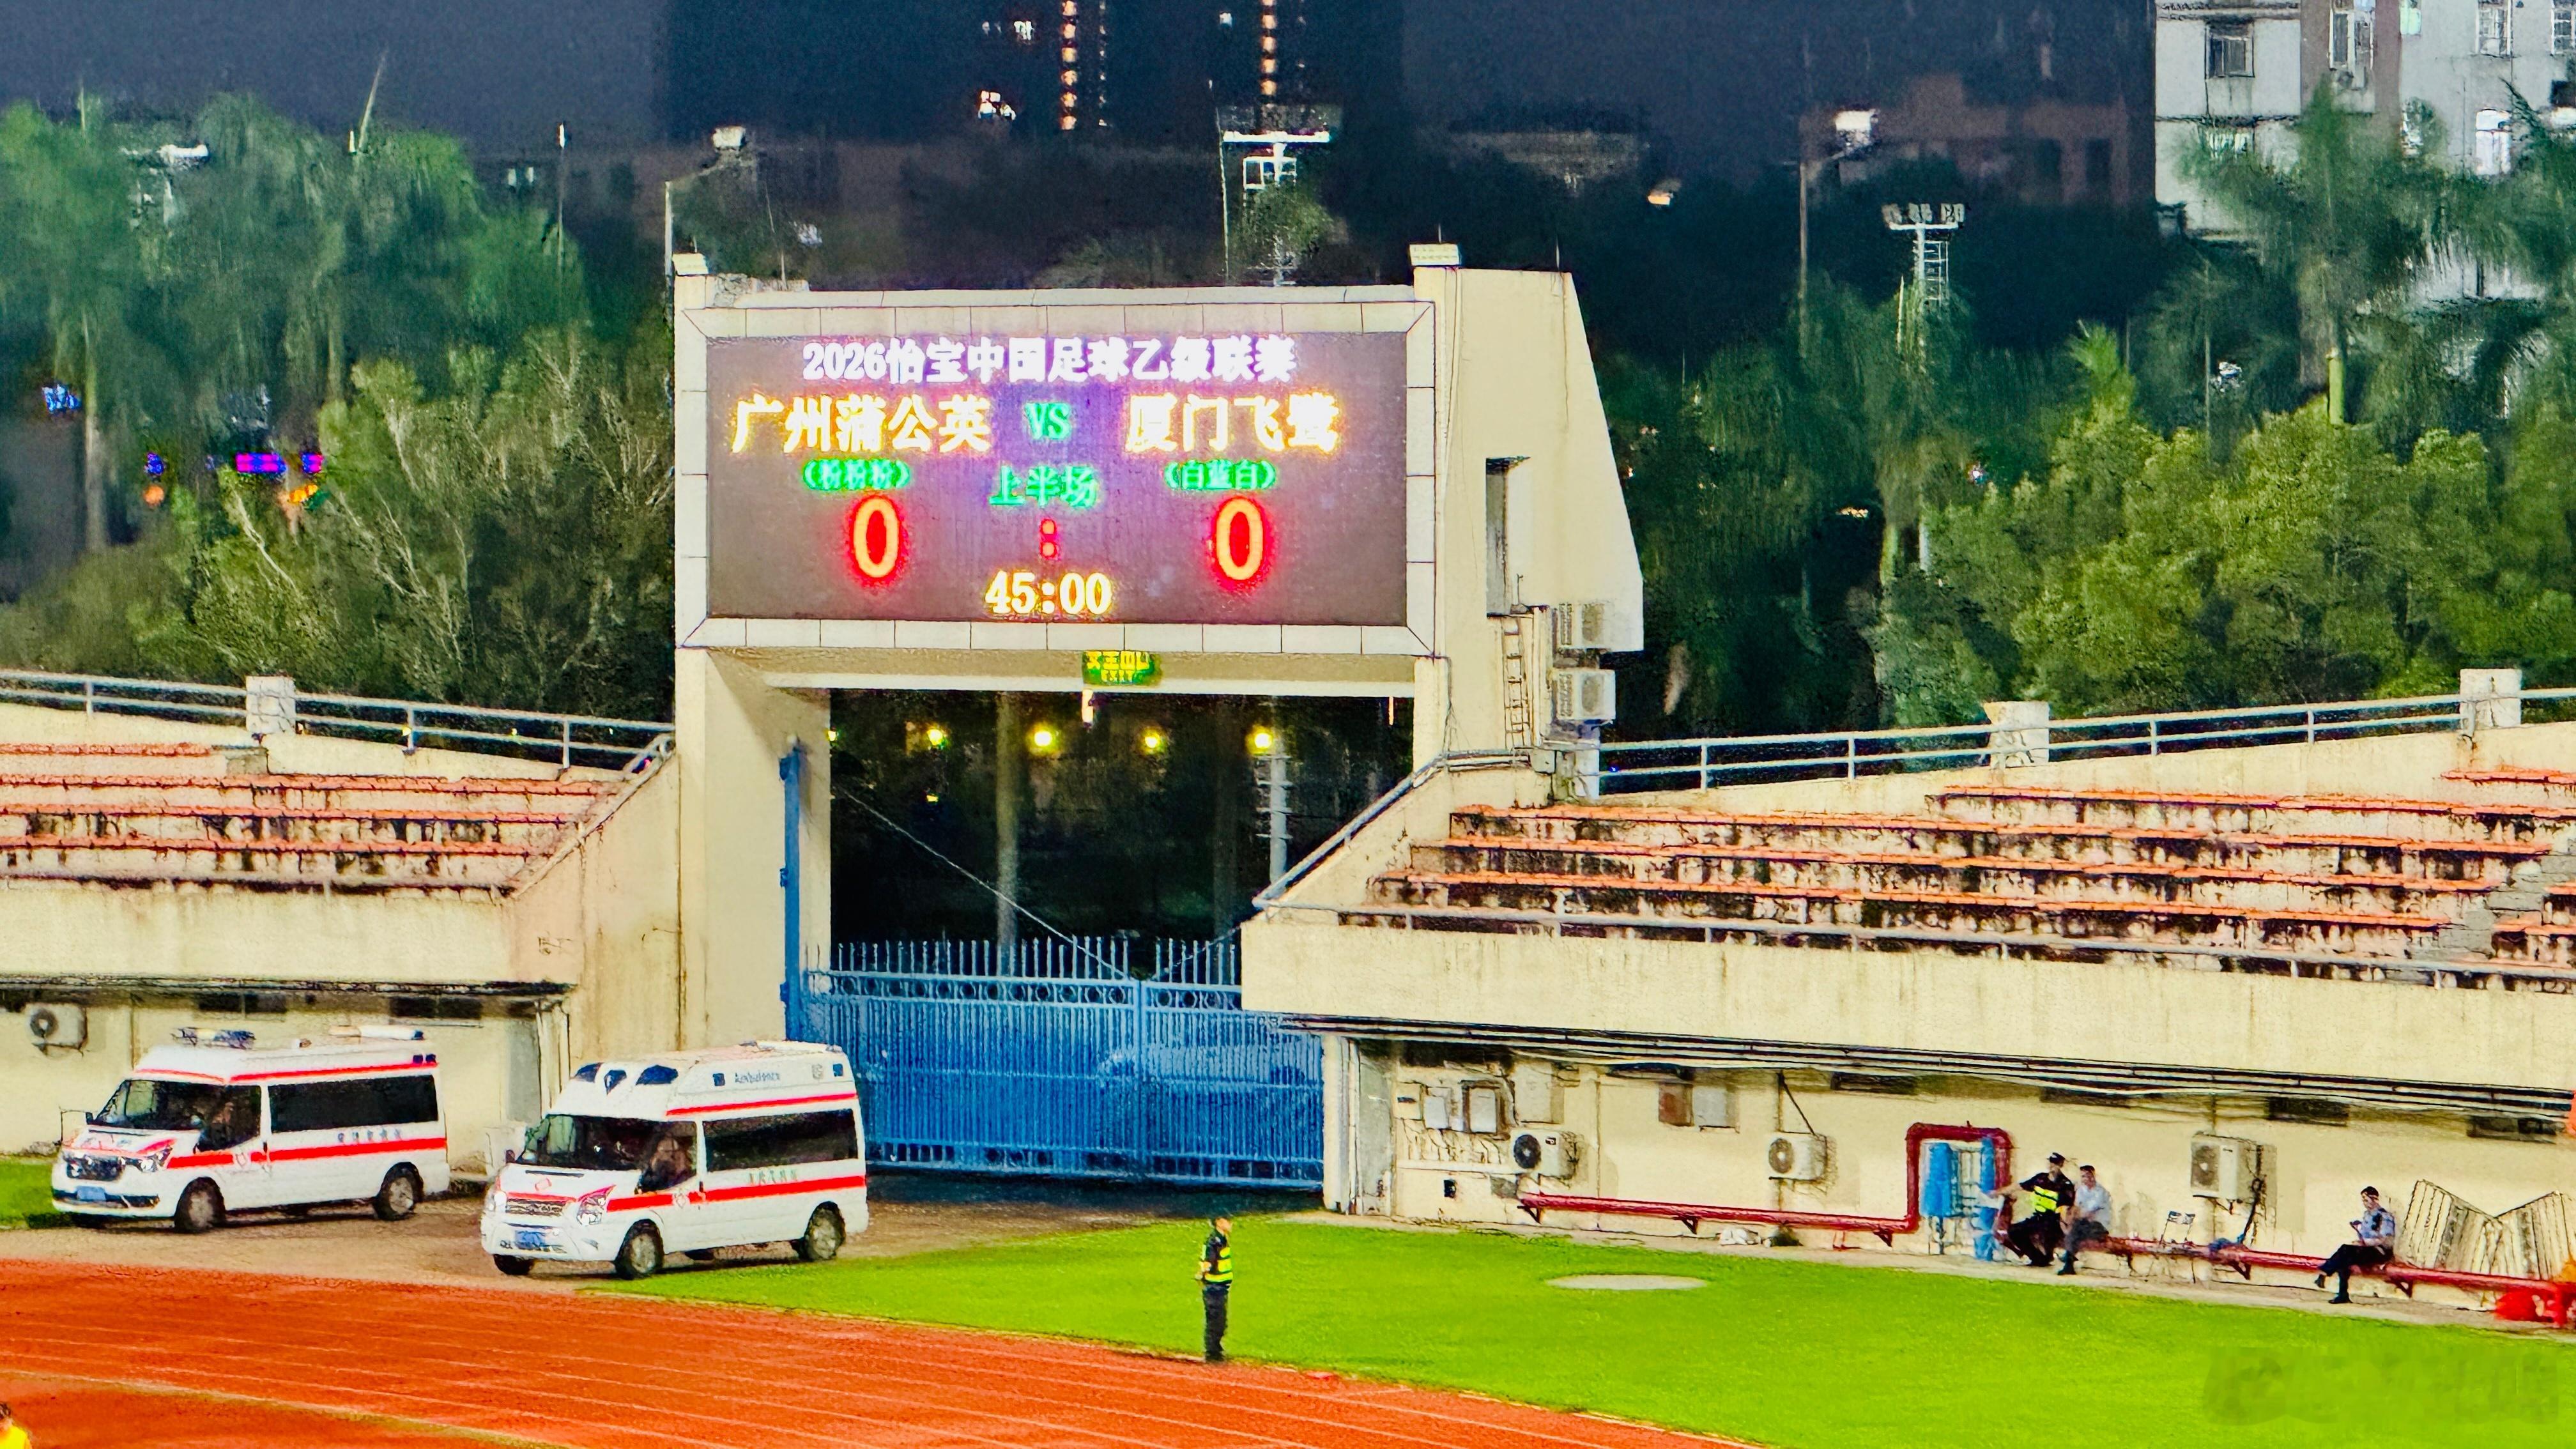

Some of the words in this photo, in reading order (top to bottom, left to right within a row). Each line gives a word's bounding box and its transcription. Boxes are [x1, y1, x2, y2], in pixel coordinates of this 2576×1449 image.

[802, 335, 1298, 383] 2026怡宝中国足球乙级联赛
[732, 394, 992, 452] 广州蒲公英
[1025, 402, 1072, 440] VS
[1125, 392, 1339, 452] 厦门飞鹭
[989, 465, 1100, 509] 上半场
[854, 496, 900, 578] 0
[1217, 496, 1264, 579] 0
[985, 571, 1113, 615] 45:00
